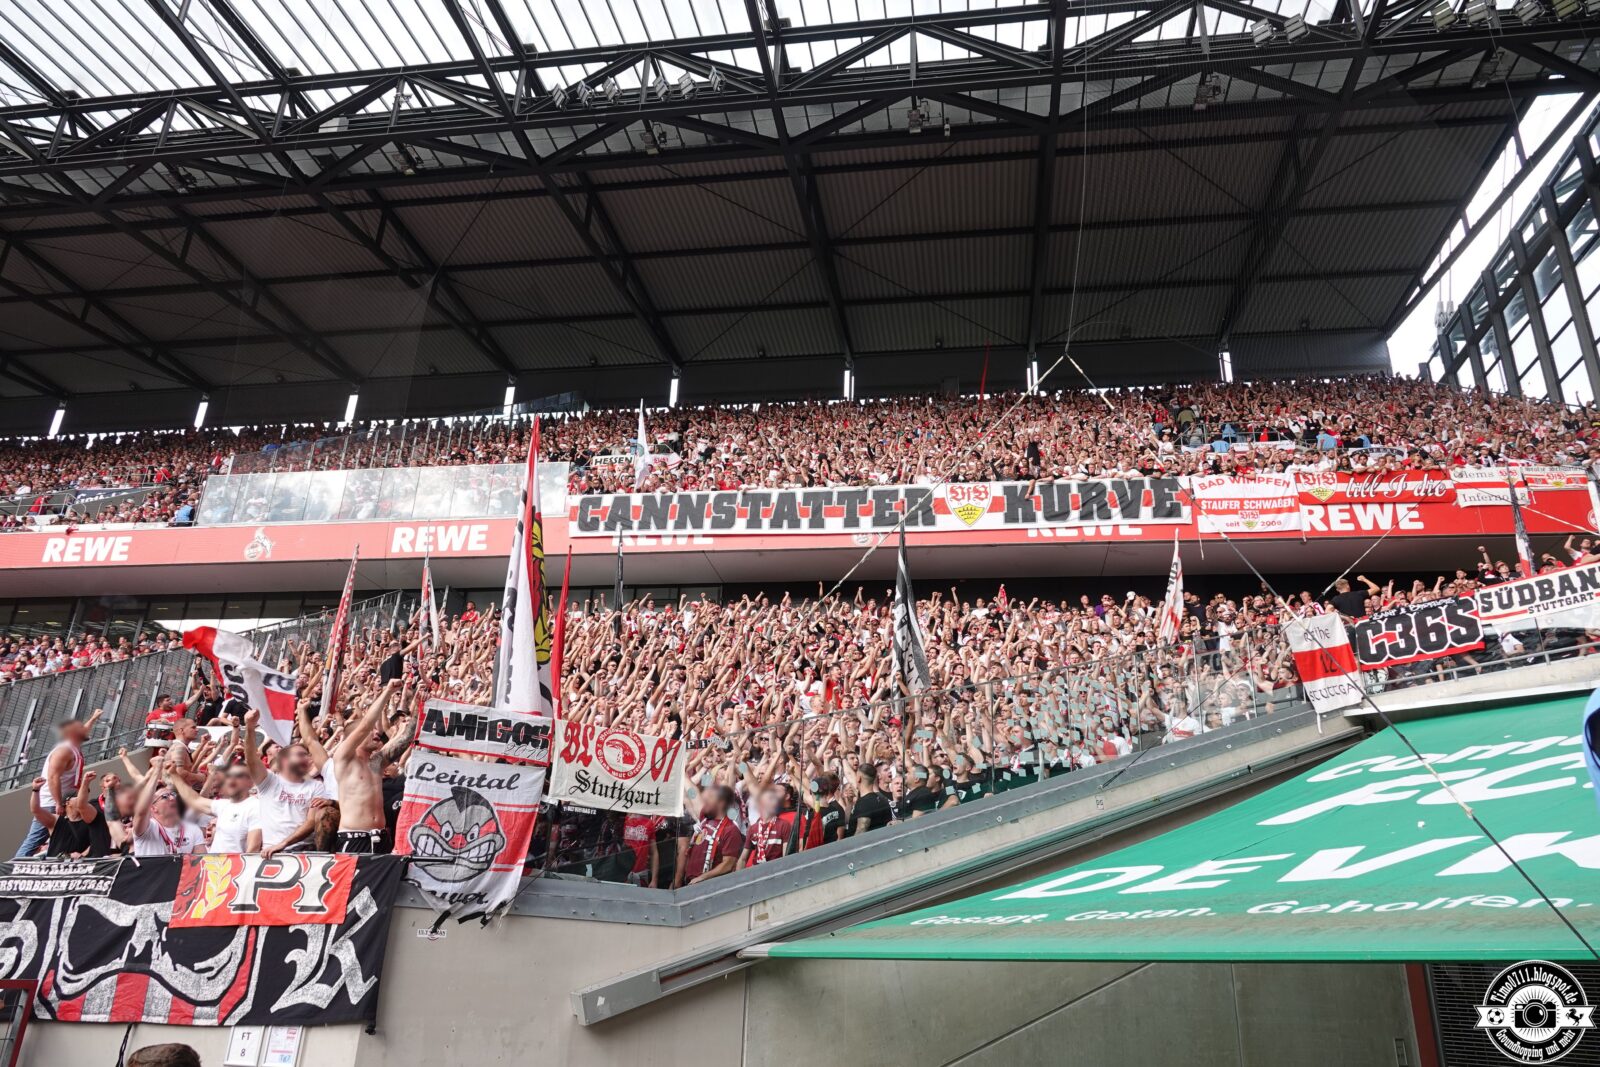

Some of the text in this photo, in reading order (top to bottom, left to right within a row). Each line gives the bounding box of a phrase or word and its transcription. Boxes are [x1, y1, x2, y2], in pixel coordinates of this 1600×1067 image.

[594, 456, 633, 466] HESSEN
[1198, 475, 1291, 491] BAD WIMPFEN
[1345, 472, 1378, 498] till
[1413, 473, 1447, 497] die
[576, 478, 1183, 532] CANNSTATTER KURVE
[1201, 497, 1295, 511] STAUFER SCHWABEN
[1462, 491, 1510, 502] Inferno
[1300, 502, 1424, 531] REWE
[41, 536, 133, 562] REWE
[391, 524, 489, 553] REWE
[1480, 566, 1600, 613] SÜDBAN
[1528, 592, 1594, 614] STUTTGART
[1357, 598, 1484, 664] C36S
[408, 762, 521, 791] Leintal
[568, 769, 662, 809] Stuttgart
[990, 831, 1600, 901] DEVK
[69, 879, 112, 892] ULTRAS
[227, 854, 337, 914] PI
[1064, 906, 1217, 921] Getan.
[1246, 894, 1593, 914] Geholfen.
[241, 1031, 252, 1041] FT
[240, 1047, 246, 1057] 8
